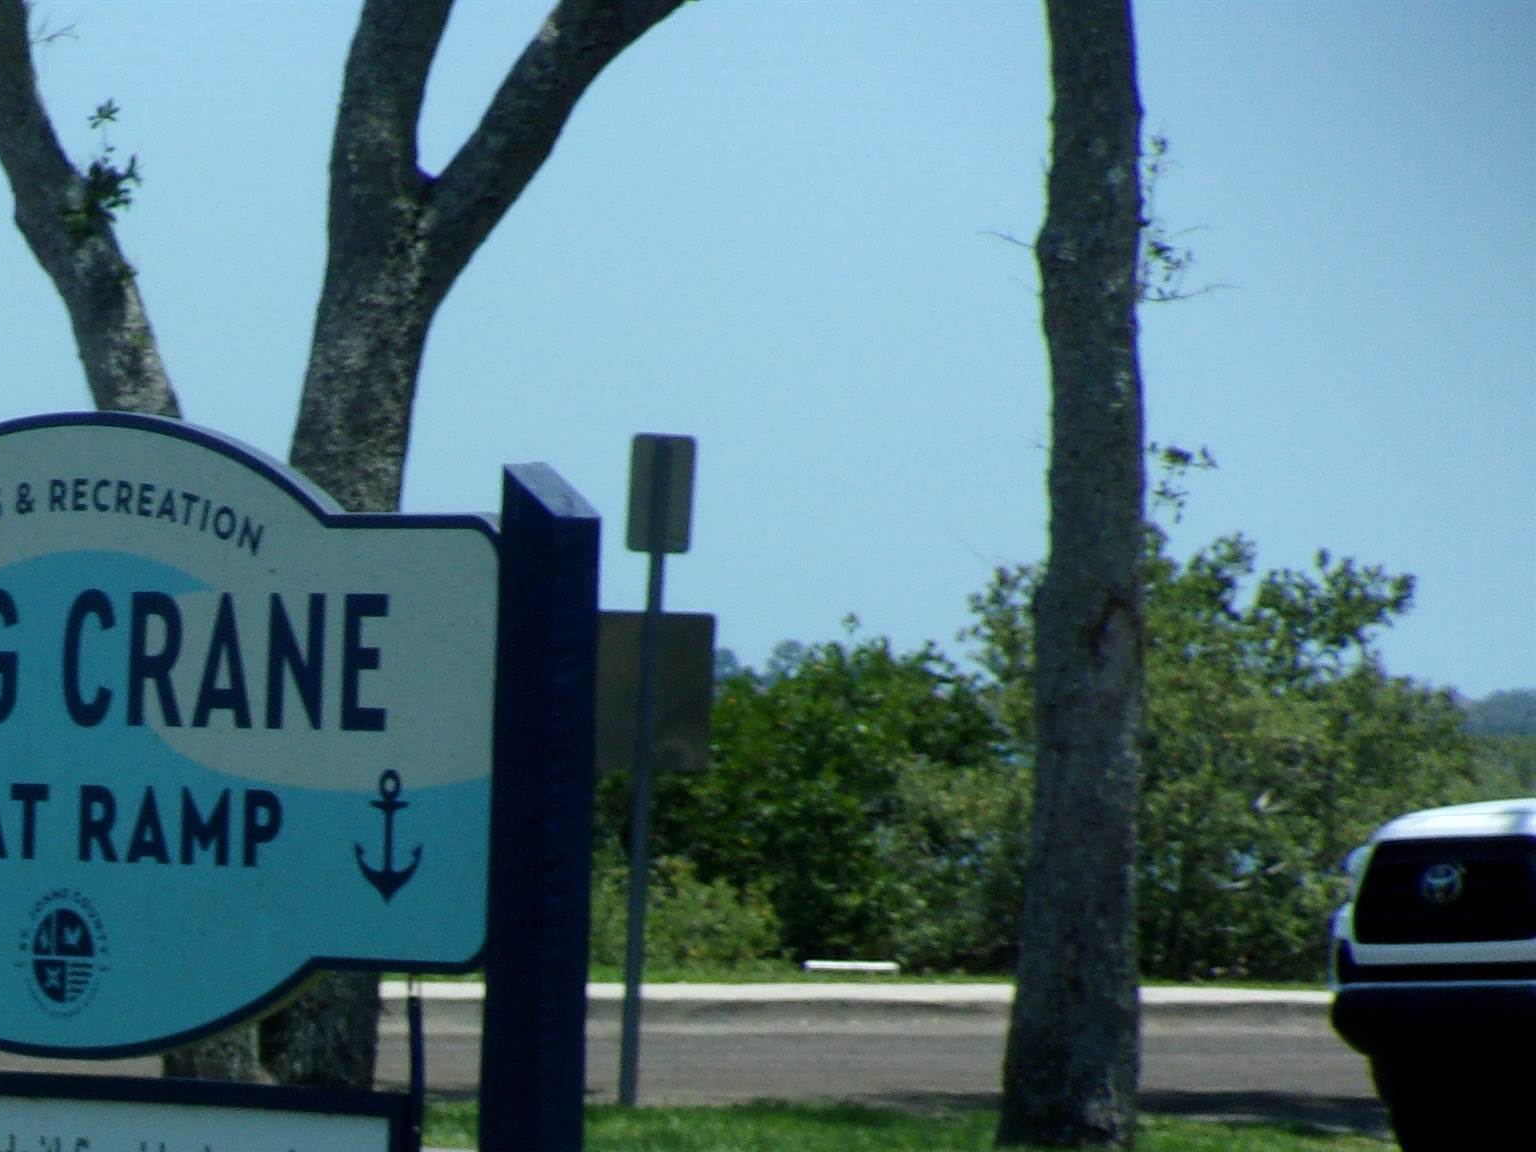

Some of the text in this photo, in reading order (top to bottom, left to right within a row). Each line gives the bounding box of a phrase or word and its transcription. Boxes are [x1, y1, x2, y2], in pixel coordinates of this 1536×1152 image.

[14, 481, 35, 516] &
[48, 478, 265, 556] RECREATION
[62, 587, 390, 733] CRANE
[77, 784, 284, 868] RAMP
